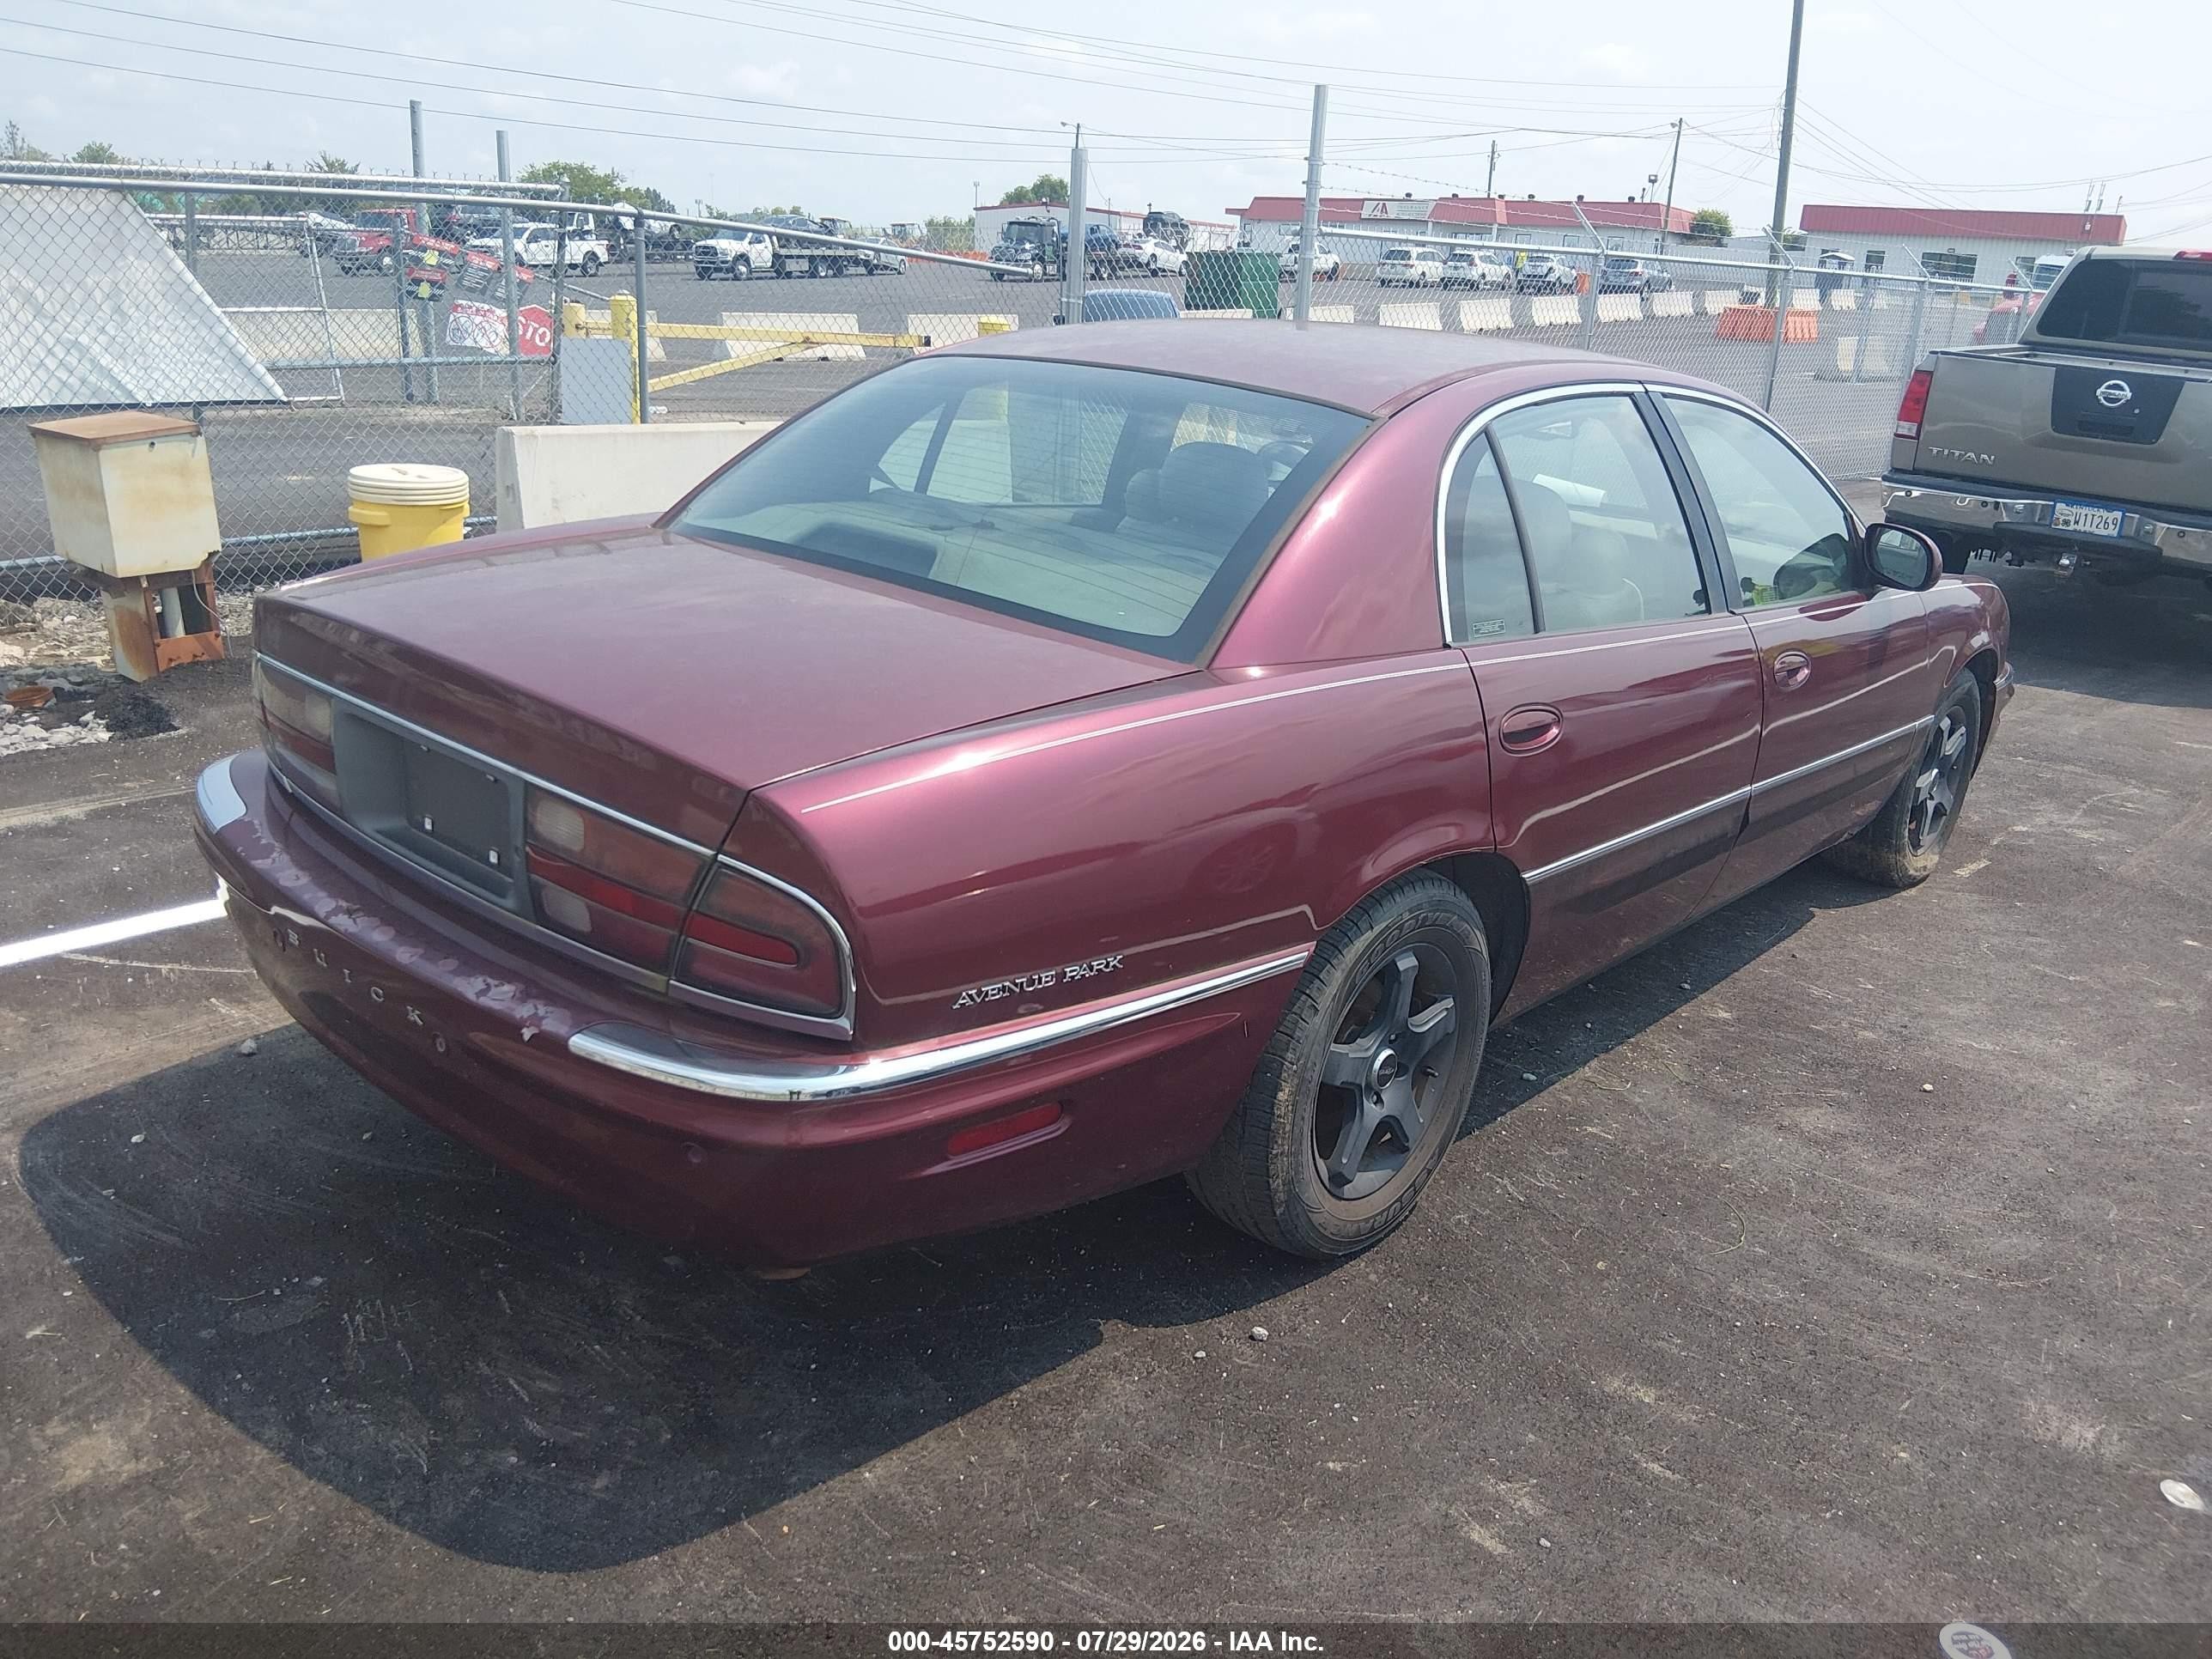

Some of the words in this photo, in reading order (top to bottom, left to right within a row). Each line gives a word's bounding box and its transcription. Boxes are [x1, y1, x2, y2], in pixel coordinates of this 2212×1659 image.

[518, 316, 550, 346] STO
[1928, 447, 1996, 465] TITAN
[2073, 511, 2118, 531] W1T269
[287, 928, 423, 1026] BUICK
[951, 969, 1056, 1010] AVENUE
[1063, 955, 1124, 982] PARK
